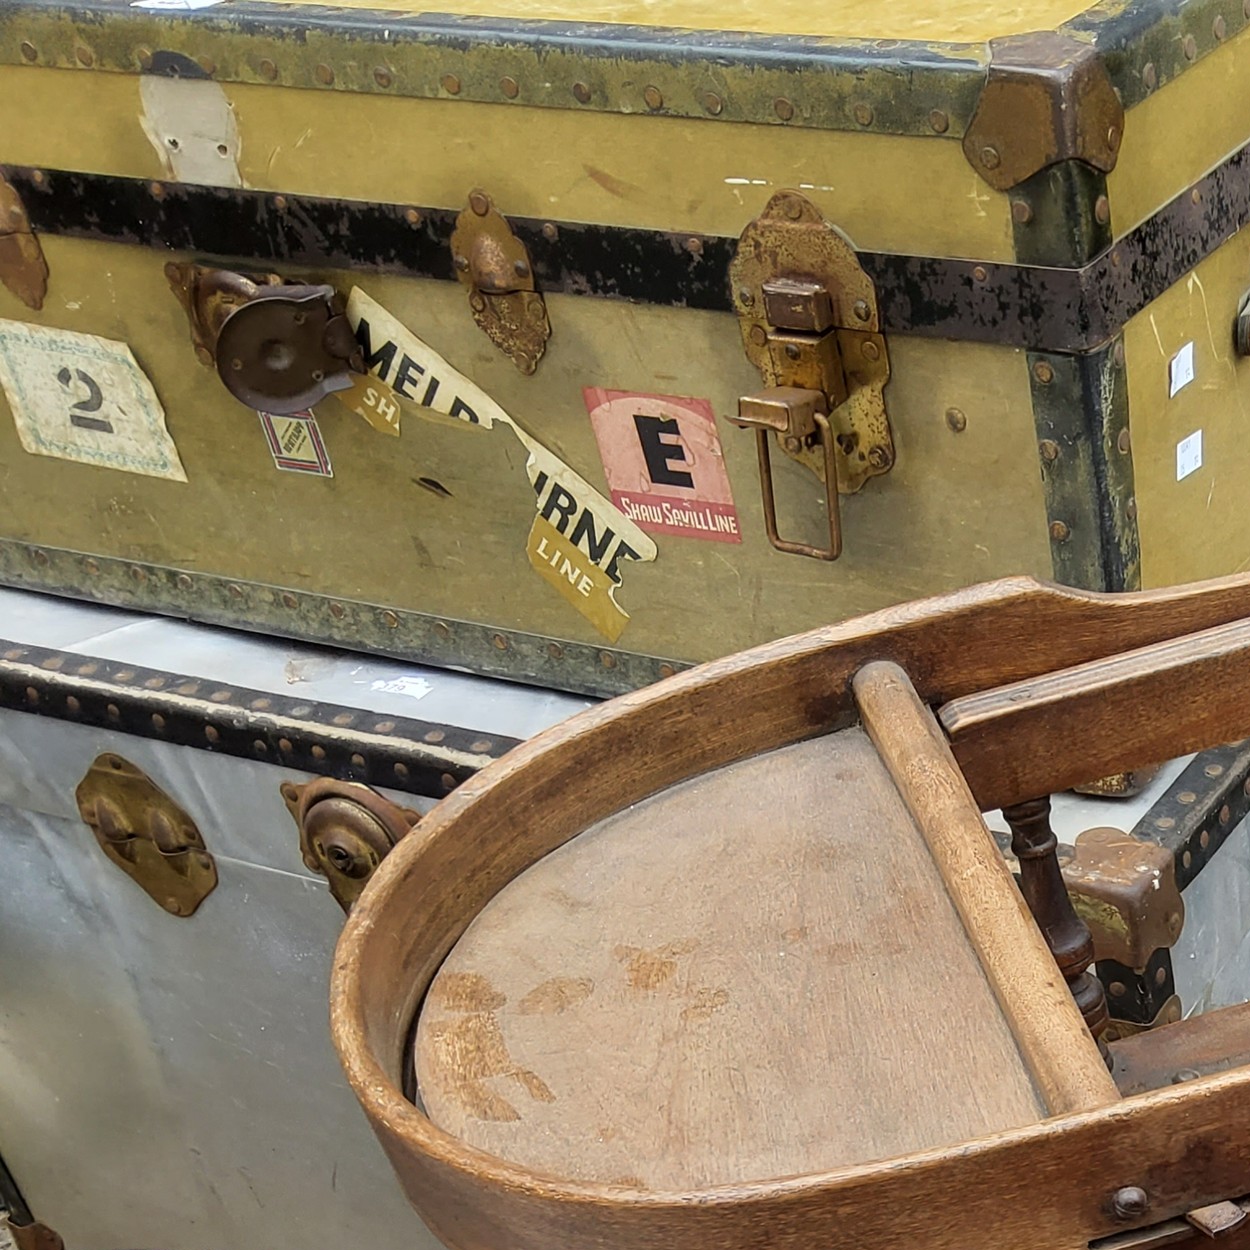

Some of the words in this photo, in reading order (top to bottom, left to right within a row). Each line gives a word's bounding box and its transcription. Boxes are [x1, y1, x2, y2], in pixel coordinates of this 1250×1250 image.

[57, 367, 114, 434] 2
[632, 414, 695, 490] E
[621, 497, 662, 526] SHAW
[706, 509, 738, 534] LINE
[536, 537, 595, 597] LINE
